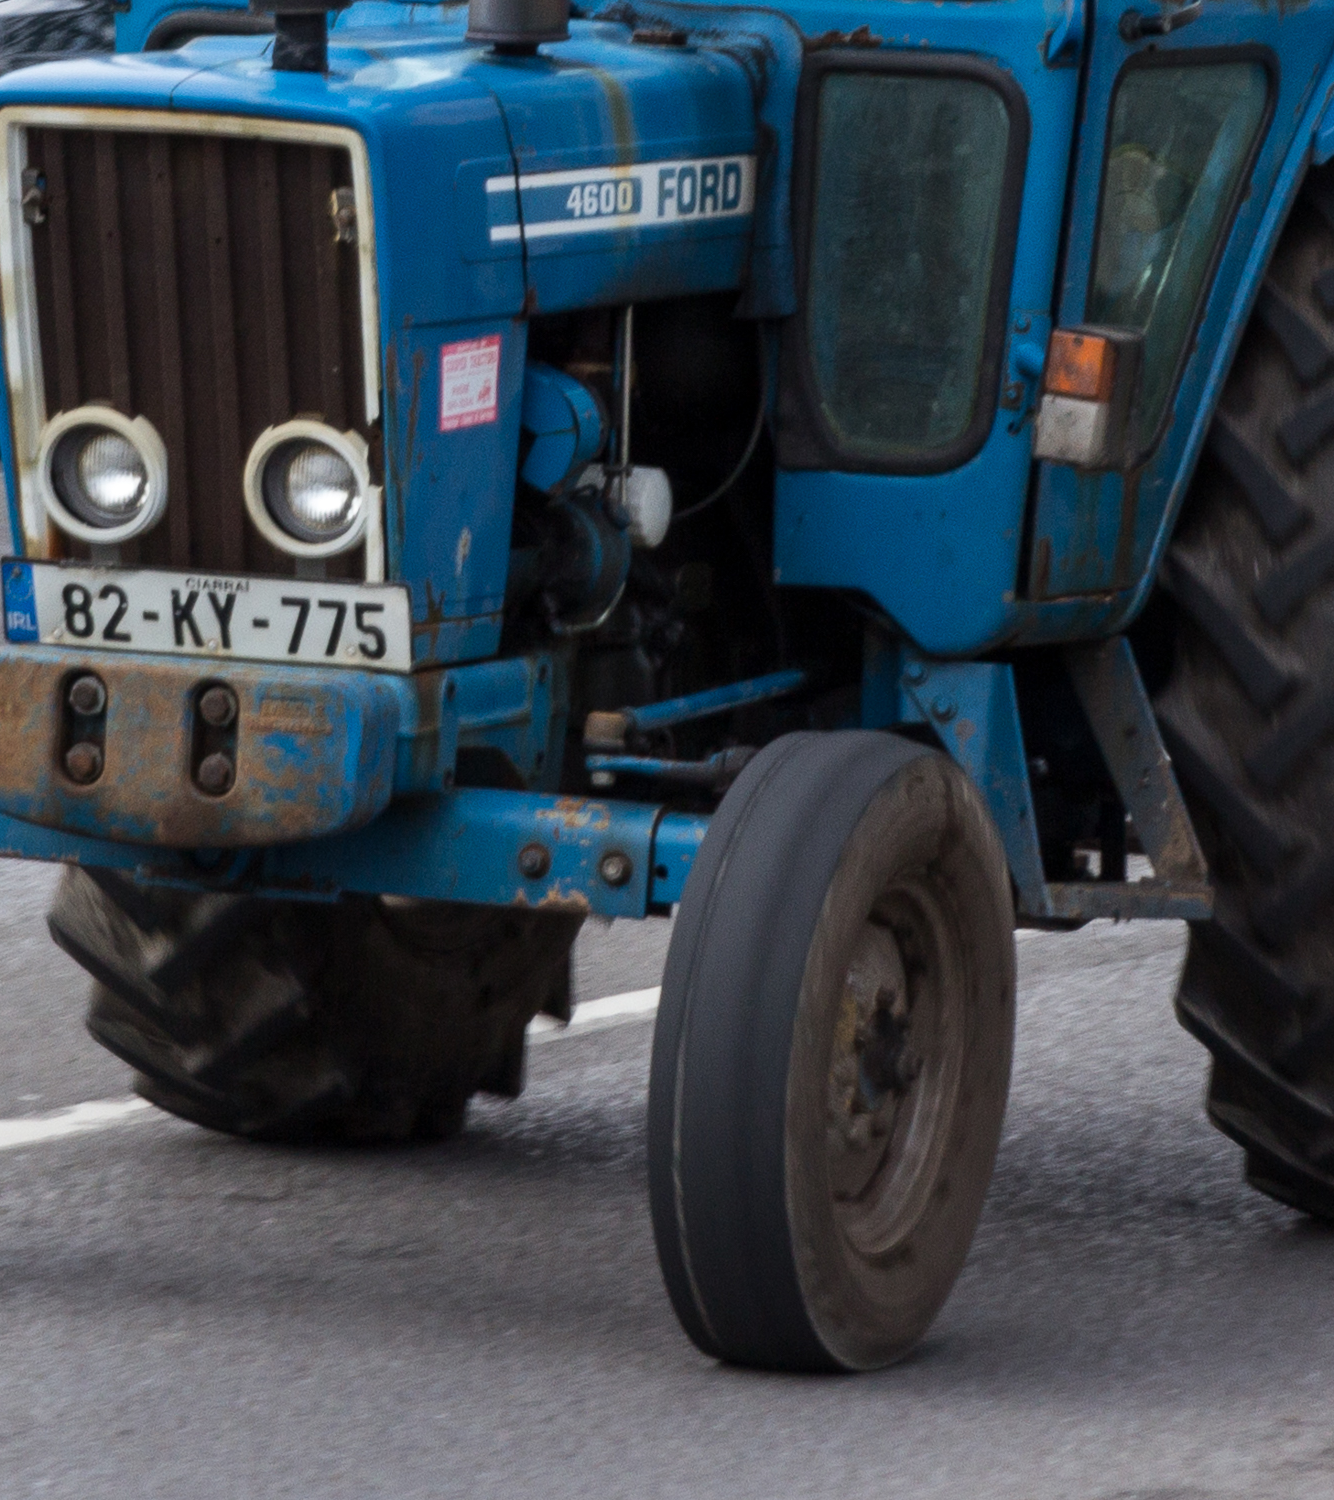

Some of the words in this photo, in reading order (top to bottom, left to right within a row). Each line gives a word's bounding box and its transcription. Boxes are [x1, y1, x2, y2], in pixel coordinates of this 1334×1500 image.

[566, 181, 633, 218] 4600
[657, 161, 743, 218] FORD
[7, 610, 38, 632] IRL
[61, 583, 386, 661] 82-KY-775
